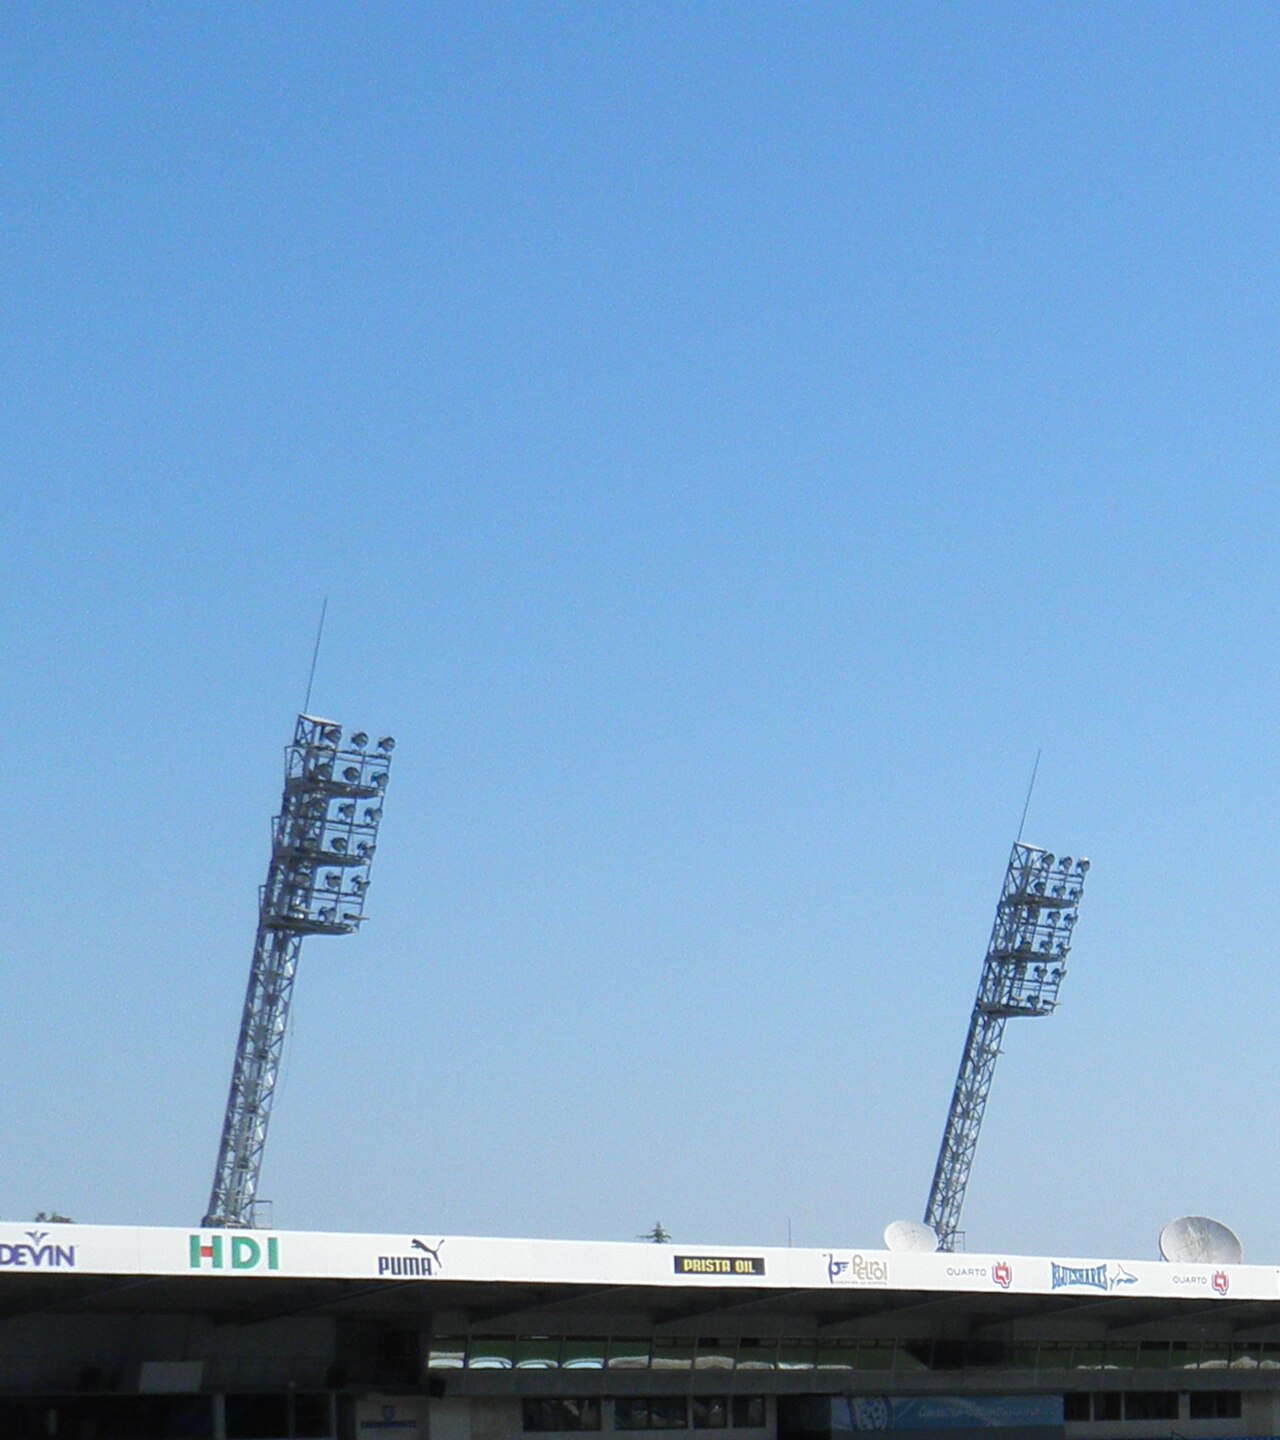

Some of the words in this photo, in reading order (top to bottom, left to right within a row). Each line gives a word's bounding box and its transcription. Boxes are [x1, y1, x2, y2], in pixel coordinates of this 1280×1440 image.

[0, 1244, 75, 1268] DEVIN
[189, 1234, 279, 1271] HDI
[378, 1255, 433, 1276] PUMA
[683, 1258, 731, 1273] PRISTA
[735, 1260, 756, 1274] OIL
[946, 1266, 988, 1277] QUARTO
[1050, 1261, 1108, 1291] BLUESHARKS
[1172, 1275, 1208, 1285] QUARTO
